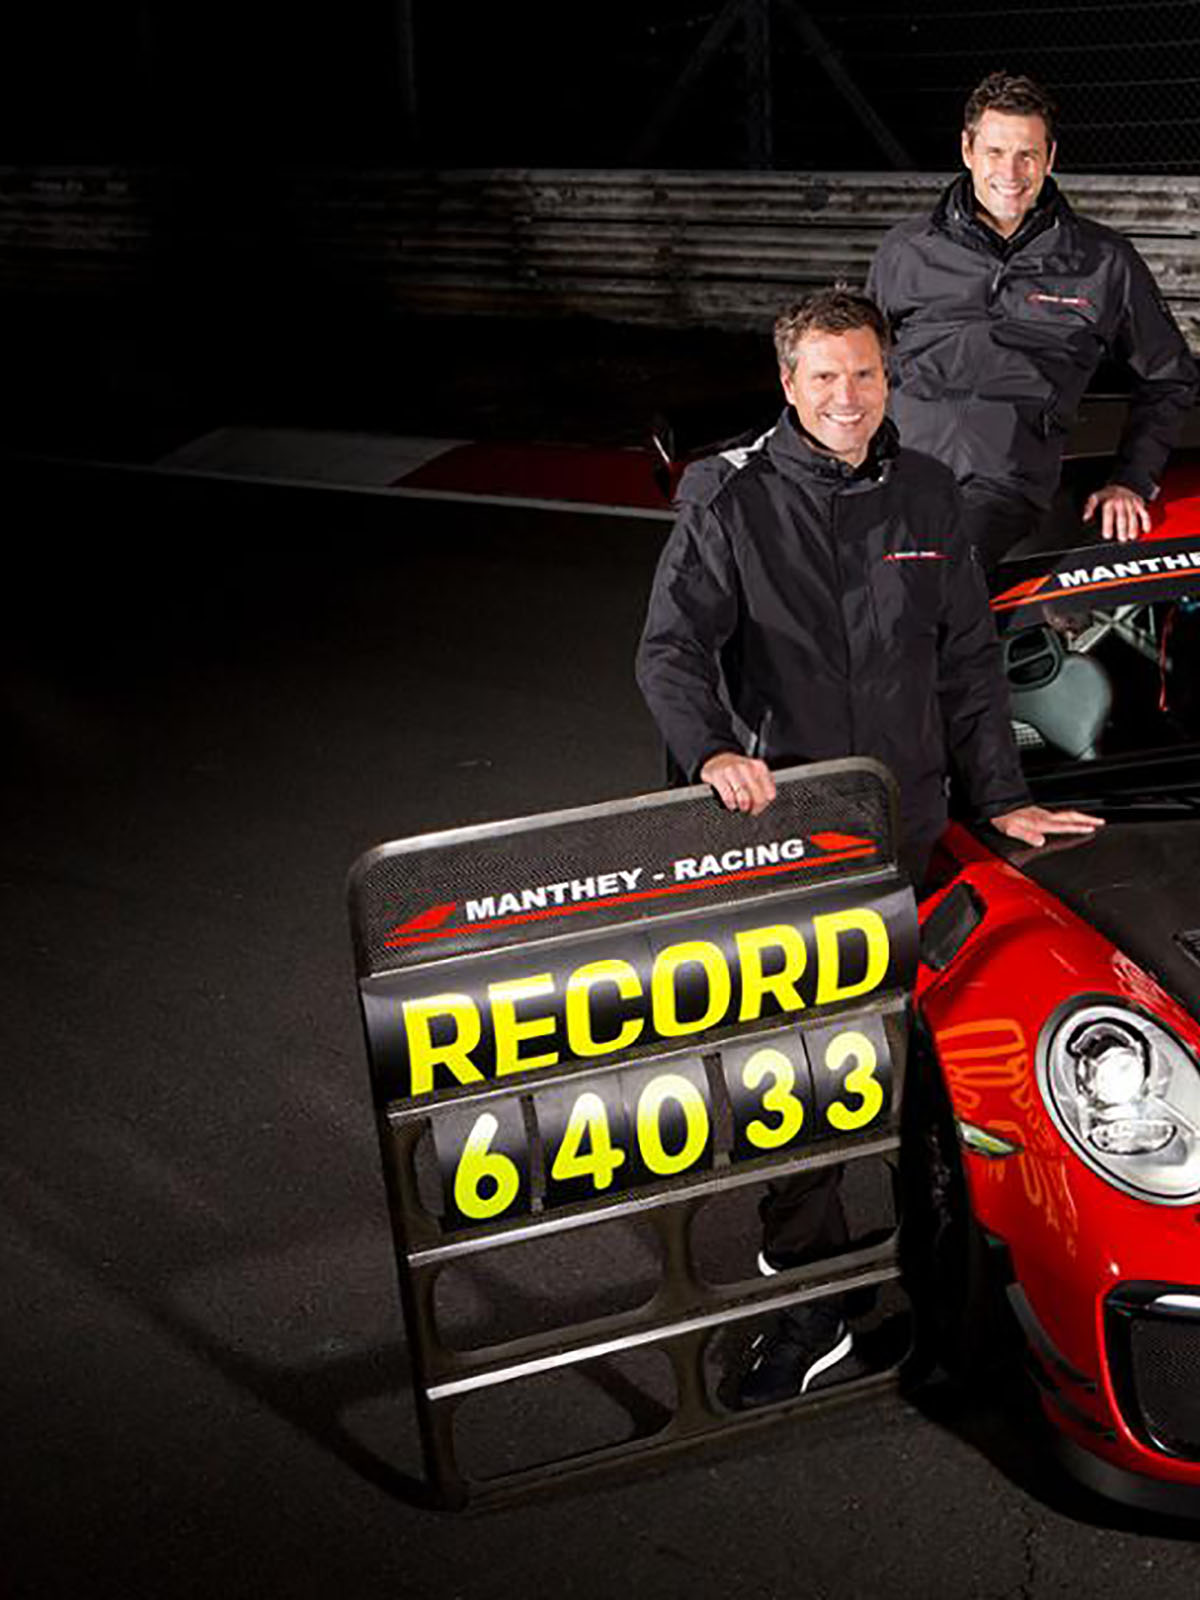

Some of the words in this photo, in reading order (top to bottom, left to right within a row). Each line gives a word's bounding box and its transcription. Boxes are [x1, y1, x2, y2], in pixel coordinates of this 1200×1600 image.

[465, 868, 642, 922] MANTHEY
[673, 840, 805, 880] RACING
[402, 908, 890, 1096] RECORD
[454, 1114, 520, 1220] 6
